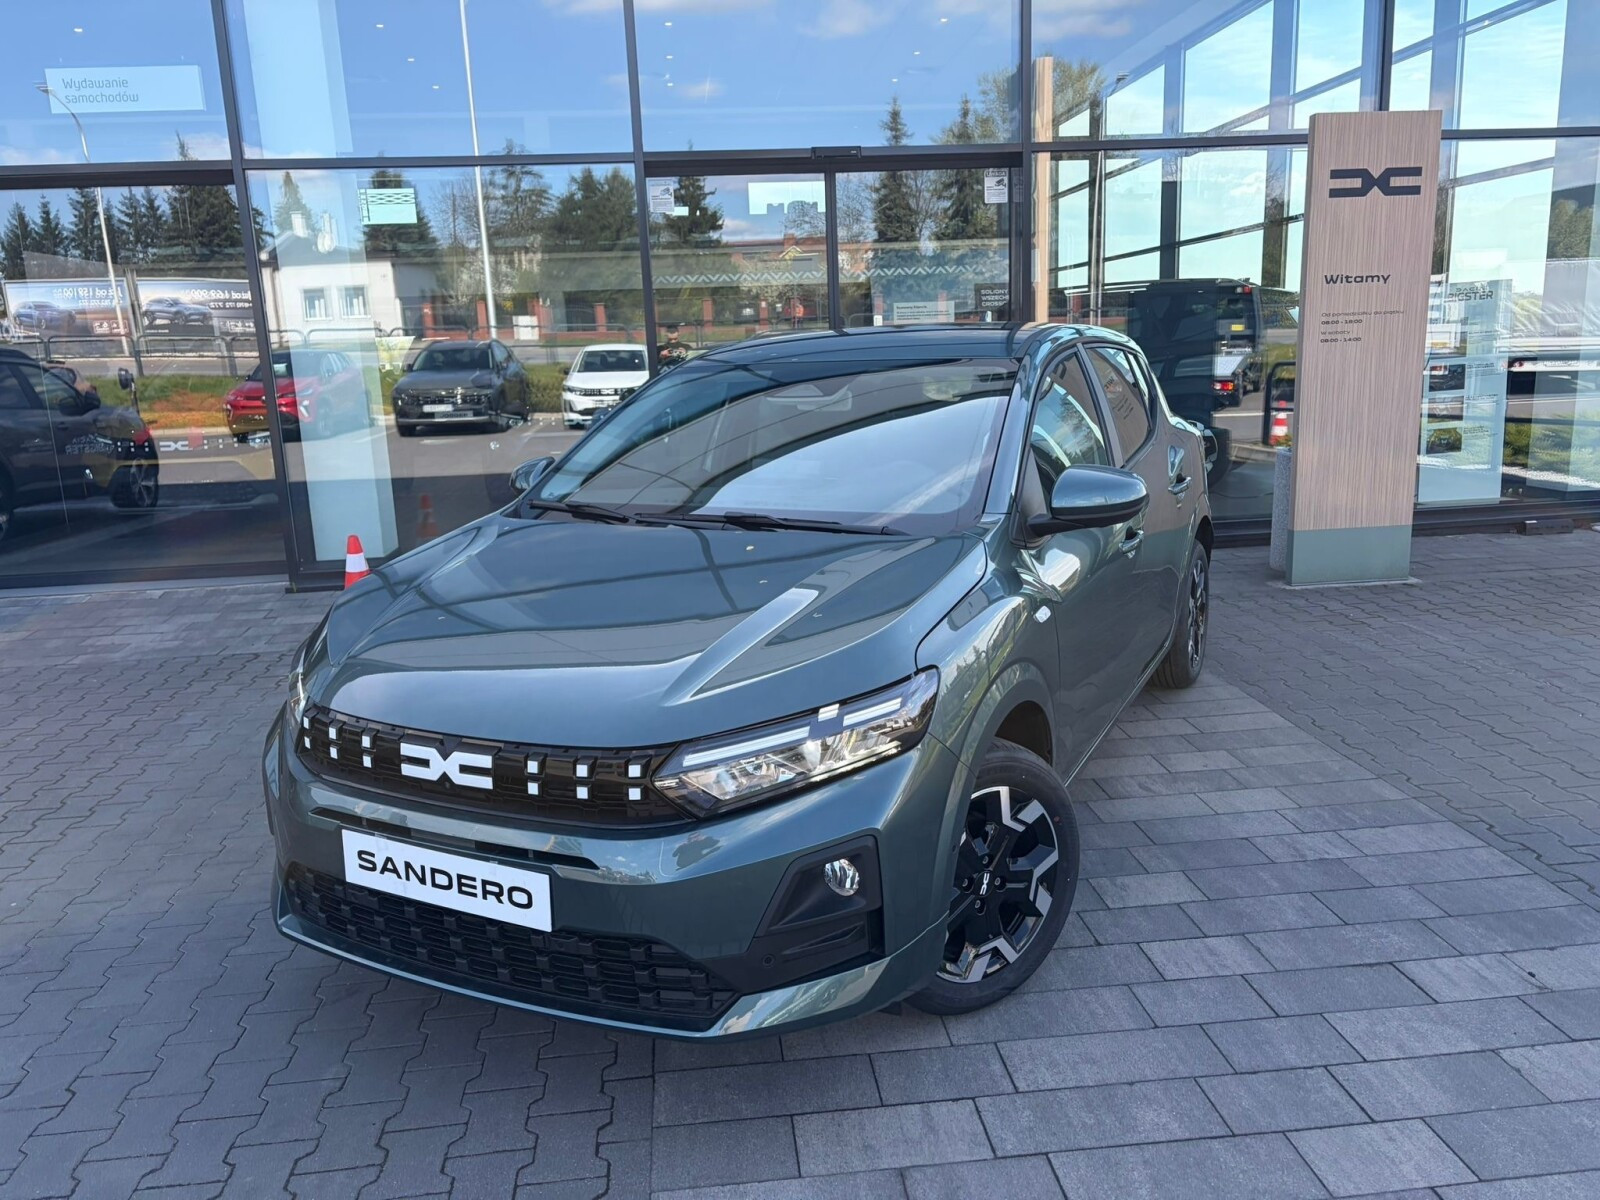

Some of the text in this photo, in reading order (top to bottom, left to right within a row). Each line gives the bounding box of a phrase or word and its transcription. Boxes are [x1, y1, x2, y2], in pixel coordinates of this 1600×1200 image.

[62, 77, 128, 91] Wydawanie
[65, 91, 139, 103] samochodów
[1324, 274, 1391, 284] Witamy
[357, 850, 534, 910] SANDERO
